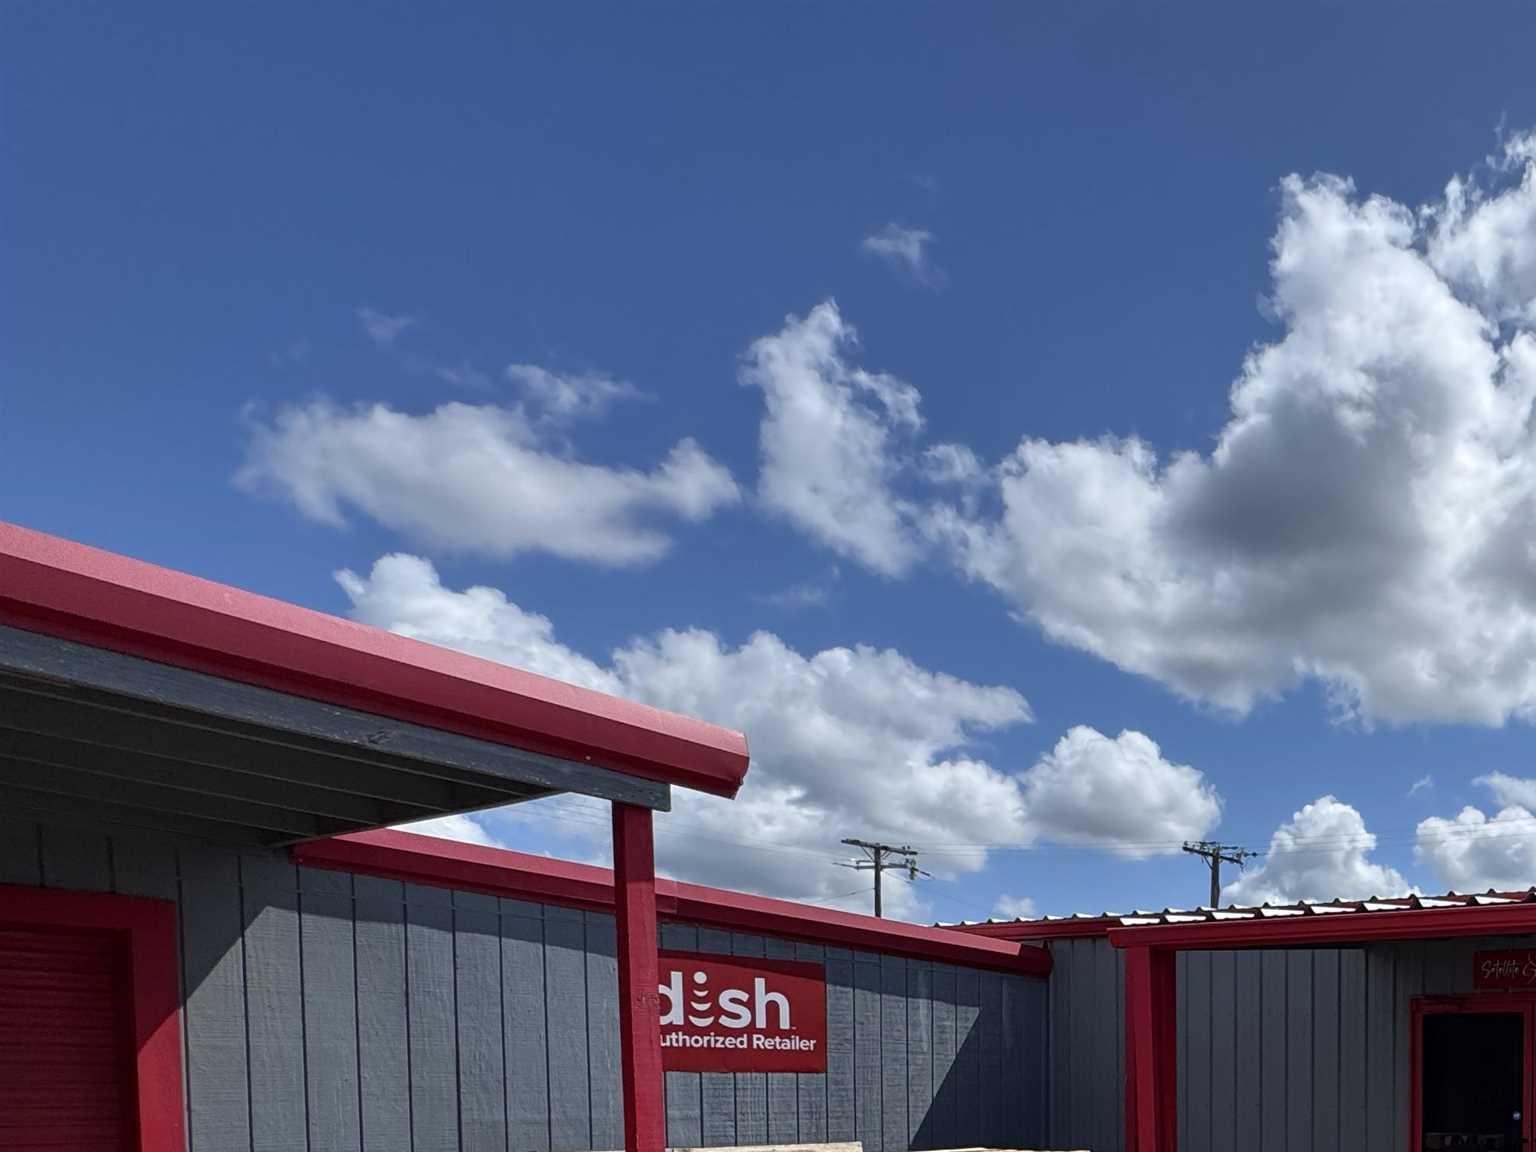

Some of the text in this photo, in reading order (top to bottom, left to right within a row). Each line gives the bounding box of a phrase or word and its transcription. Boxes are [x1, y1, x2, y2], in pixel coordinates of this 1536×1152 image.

[1481, 959, 1520, 979] Satellite
[658, 971, 791, 1030] dish
[660, 1031, 816, 1051] uthorized Retailer
